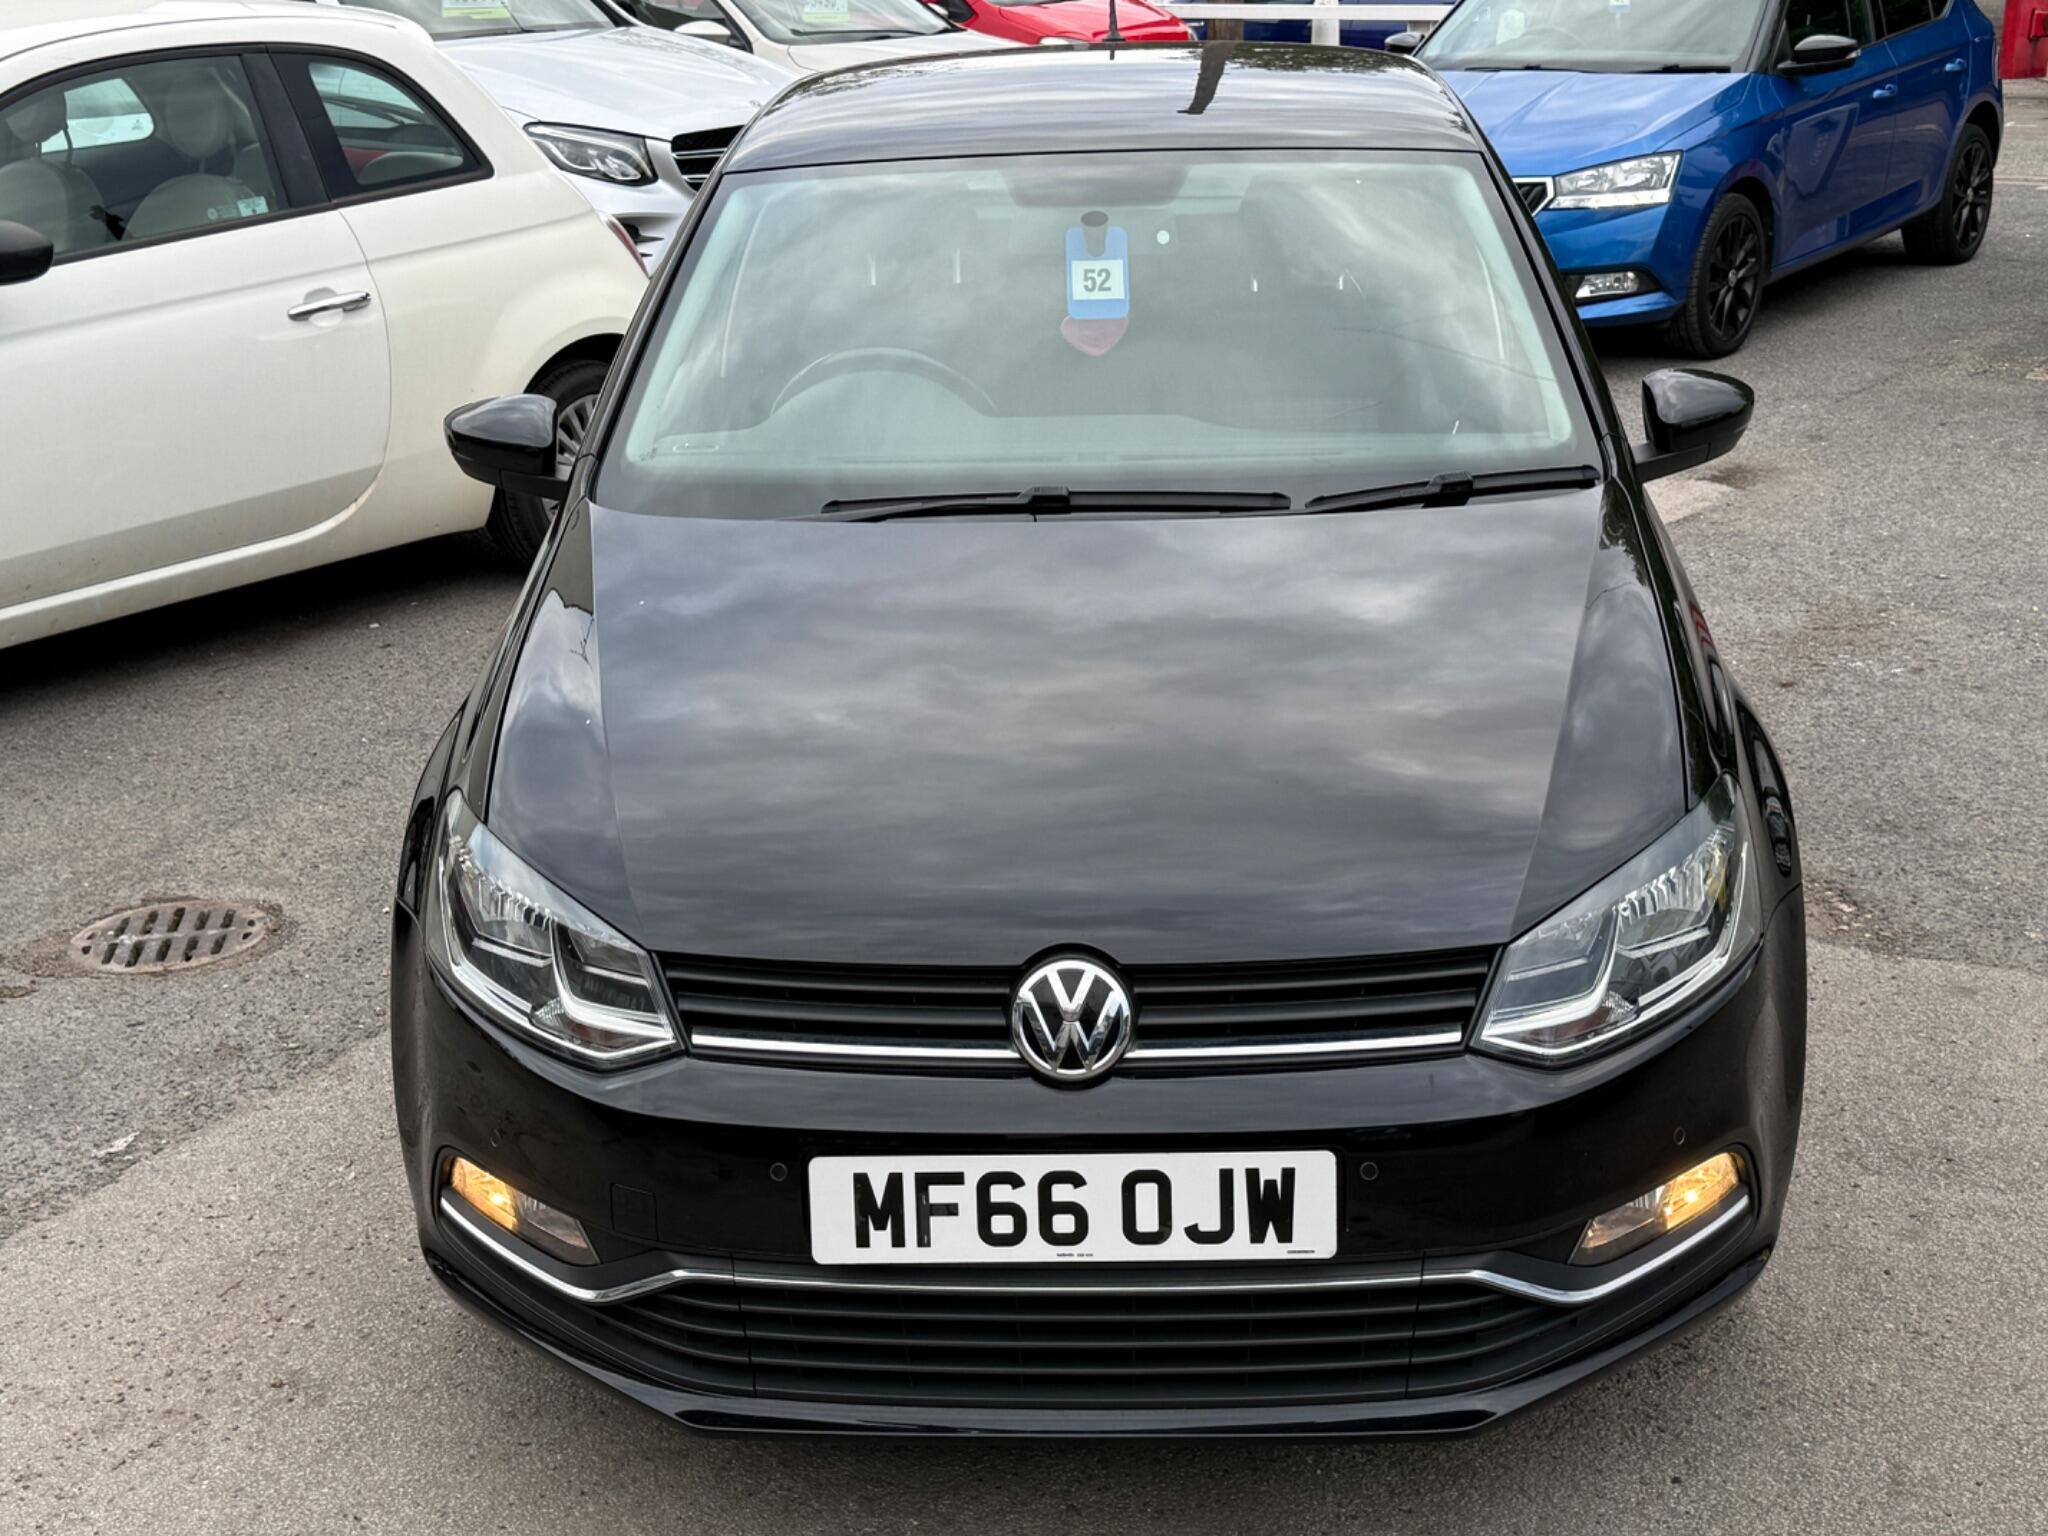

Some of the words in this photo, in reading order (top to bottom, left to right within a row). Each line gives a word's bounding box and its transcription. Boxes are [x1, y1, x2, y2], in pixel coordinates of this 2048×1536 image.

[1083, 268, 1112, 292] 52
[1014, 960, 1130, 1080] VW
[852, 1170, 1089, 1249] MF66
[1121, 1166, 1296, 1246] OJW
